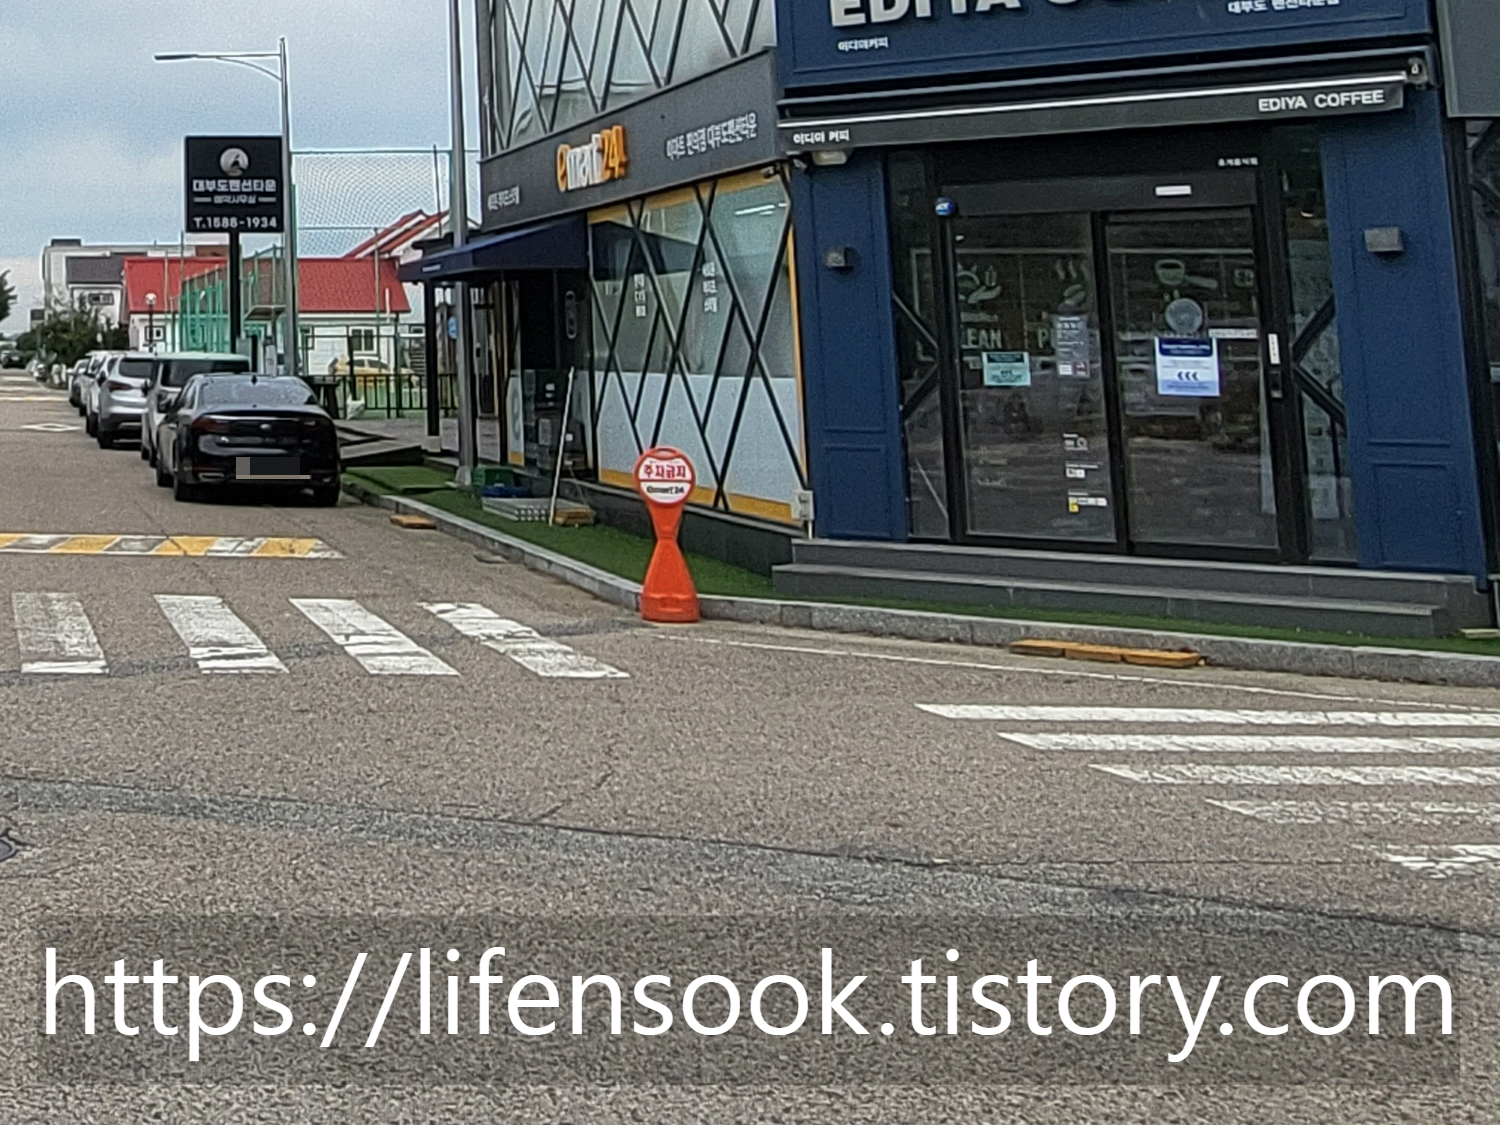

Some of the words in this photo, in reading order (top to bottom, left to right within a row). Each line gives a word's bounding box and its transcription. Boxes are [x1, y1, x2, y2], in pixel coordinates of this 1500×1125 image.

[1227, 0, 1268, 13] 대부도
[1258, 94, 1308, 112] EDIYA
[1314, 89, 1385, 109] COFFEE
[793, 131, 826, 145] 이디야
[828, 129, 850, 142] 커피
[193, 179, 277, 192] 대부도펜션타운
[192, 216, 278, 229] T.1588-1934
